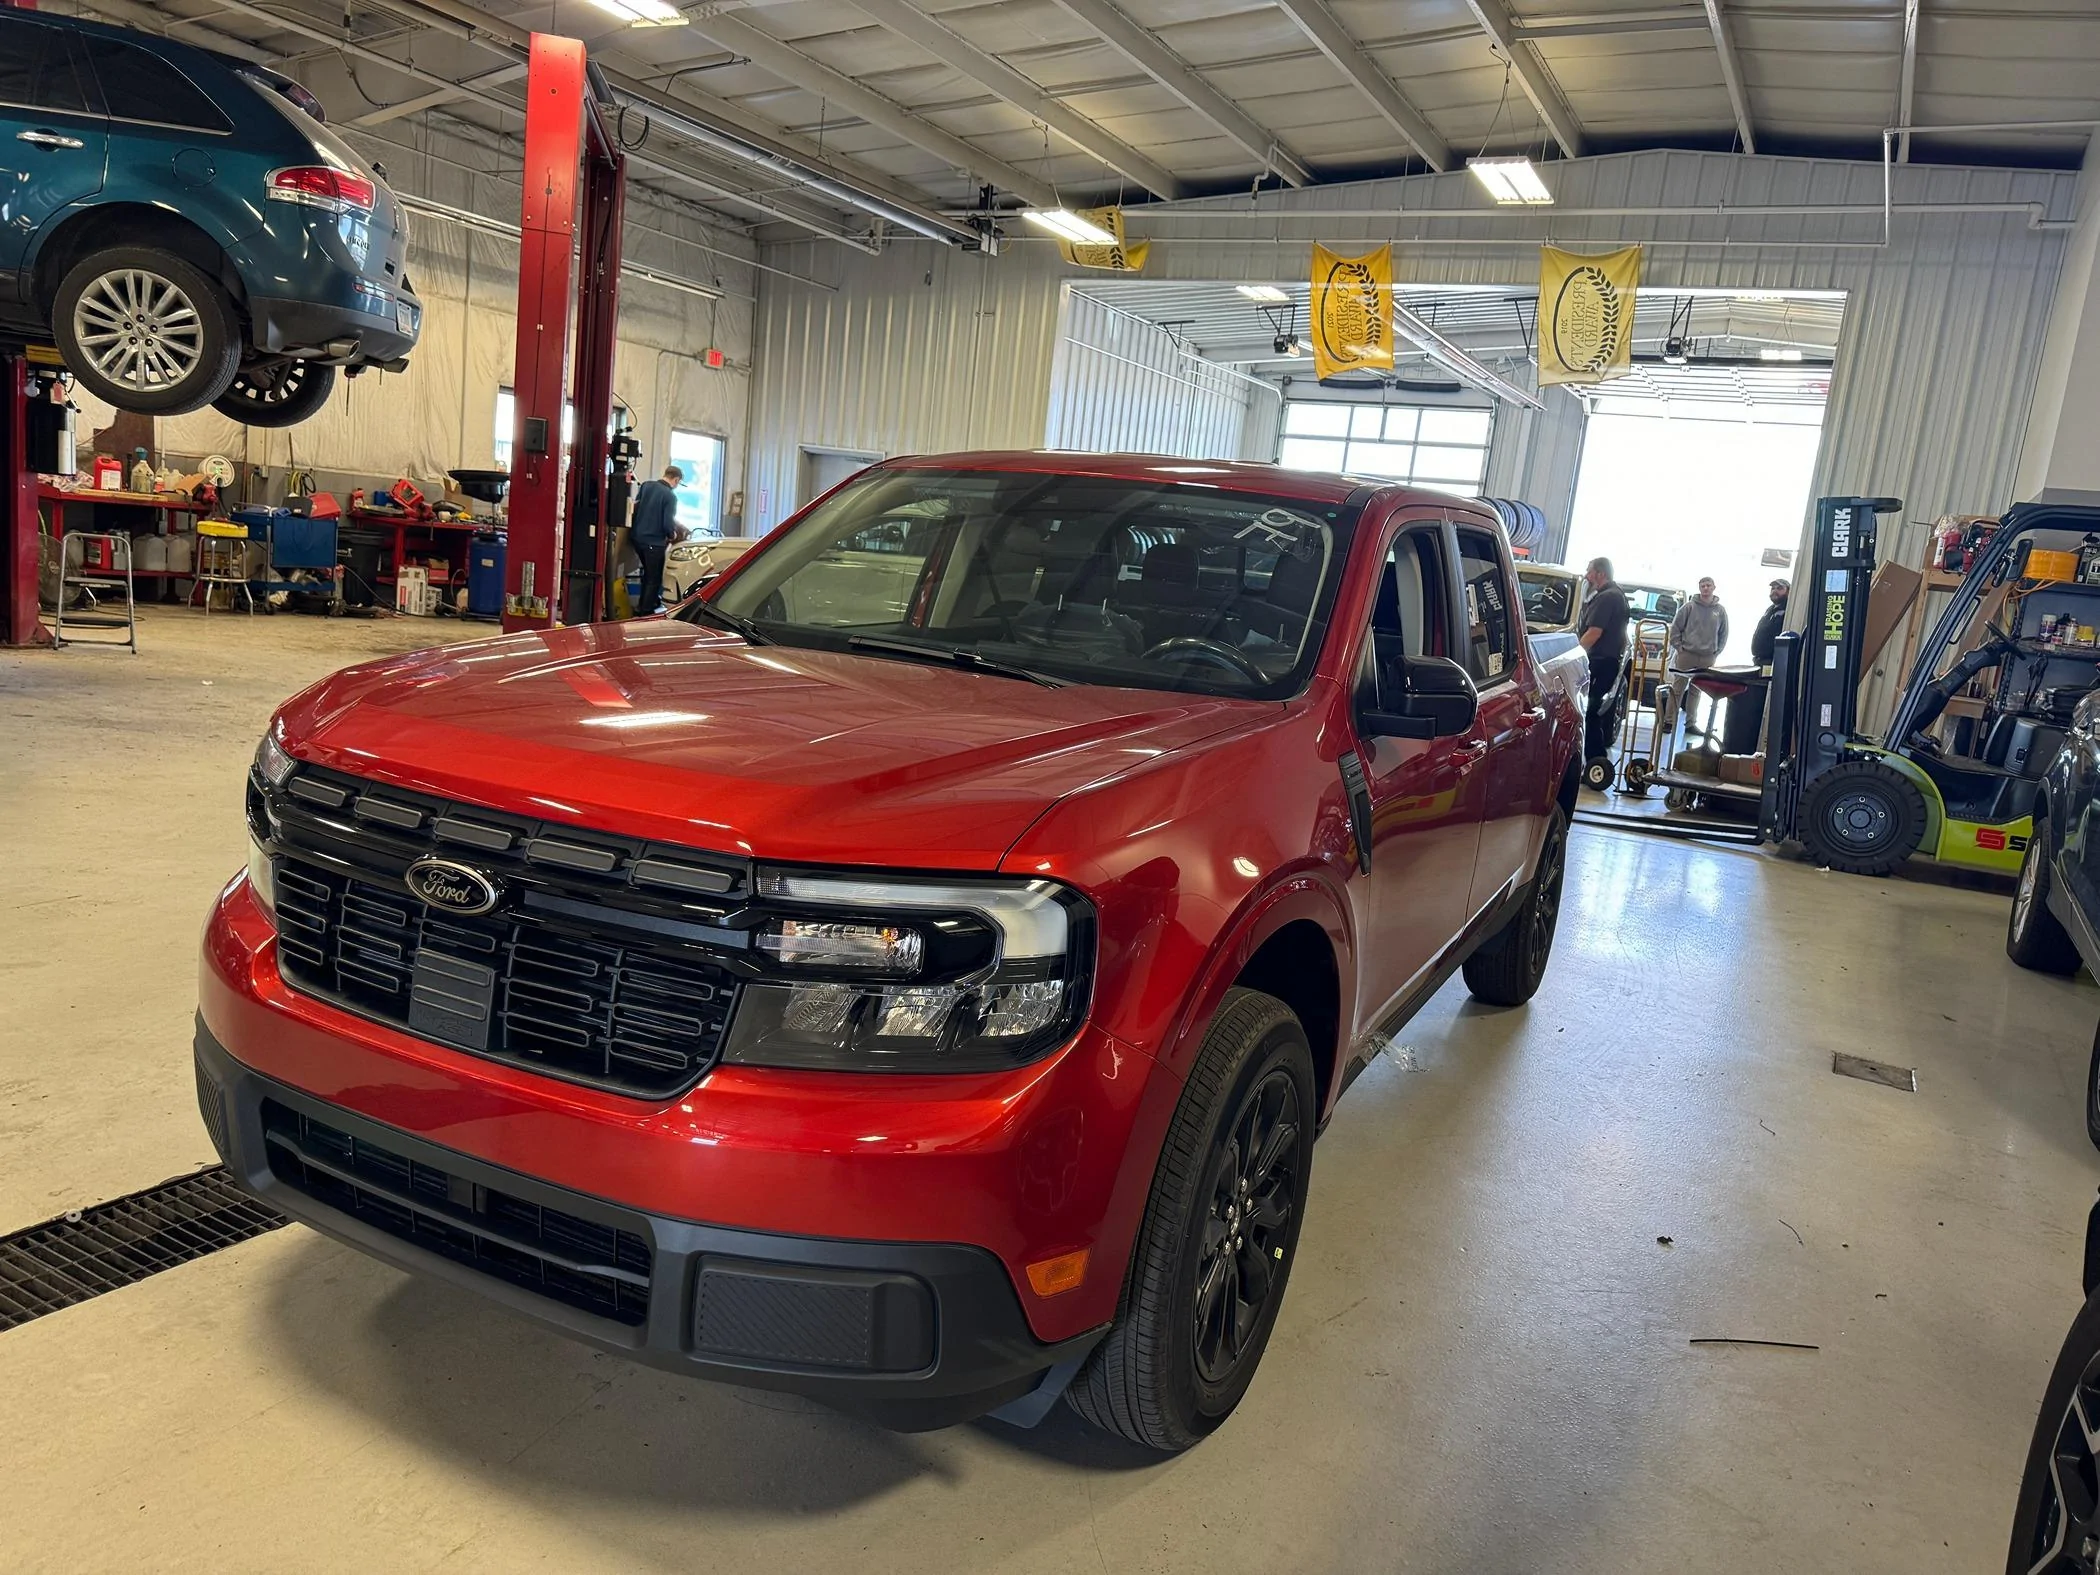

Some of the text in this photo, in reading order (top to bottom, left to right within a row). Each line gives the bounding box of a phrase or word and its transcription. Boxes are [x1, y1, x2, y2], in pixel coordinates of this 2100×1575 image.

[1832, 507, 1851, 557] CLARK
[1824, 595, 1845, 636] HOPE
[1825, 595, 1833, 621] RAISING
[422, 869, 472, 904] Ford
